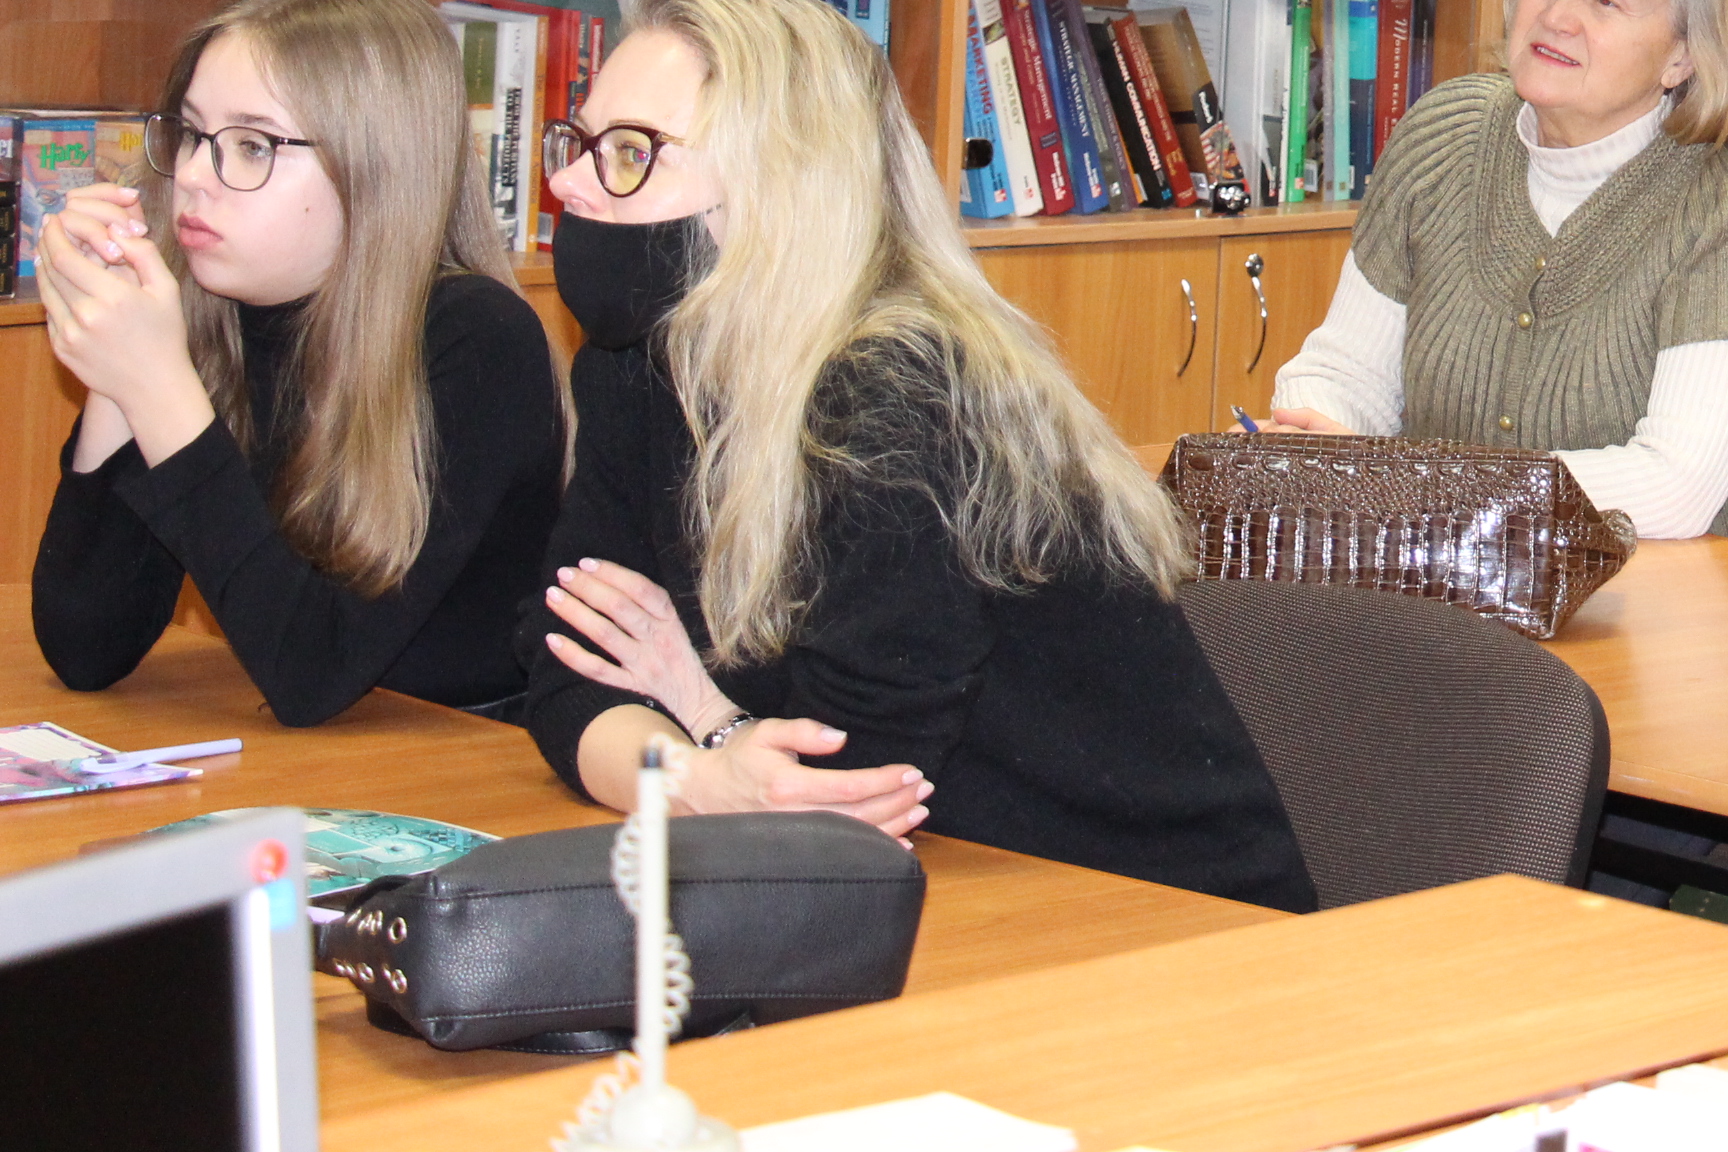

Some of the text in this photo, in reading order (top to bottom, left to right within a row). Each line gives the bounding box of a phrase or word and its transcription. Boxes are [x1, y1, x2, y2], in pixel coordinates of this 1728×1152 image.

[967, 16, 992, 115] MARKETING
[1001, 56, 1020, 125] STRATEGY
[1023, 10, 1052, 120] Strategic Management
[1058, 21, 1090, 137] STRATEGIC MANAGEMENT
[1112, 42, 1161, 171] HUMAN COMMUNICATION
[38, 143, 90, 171] Harry
